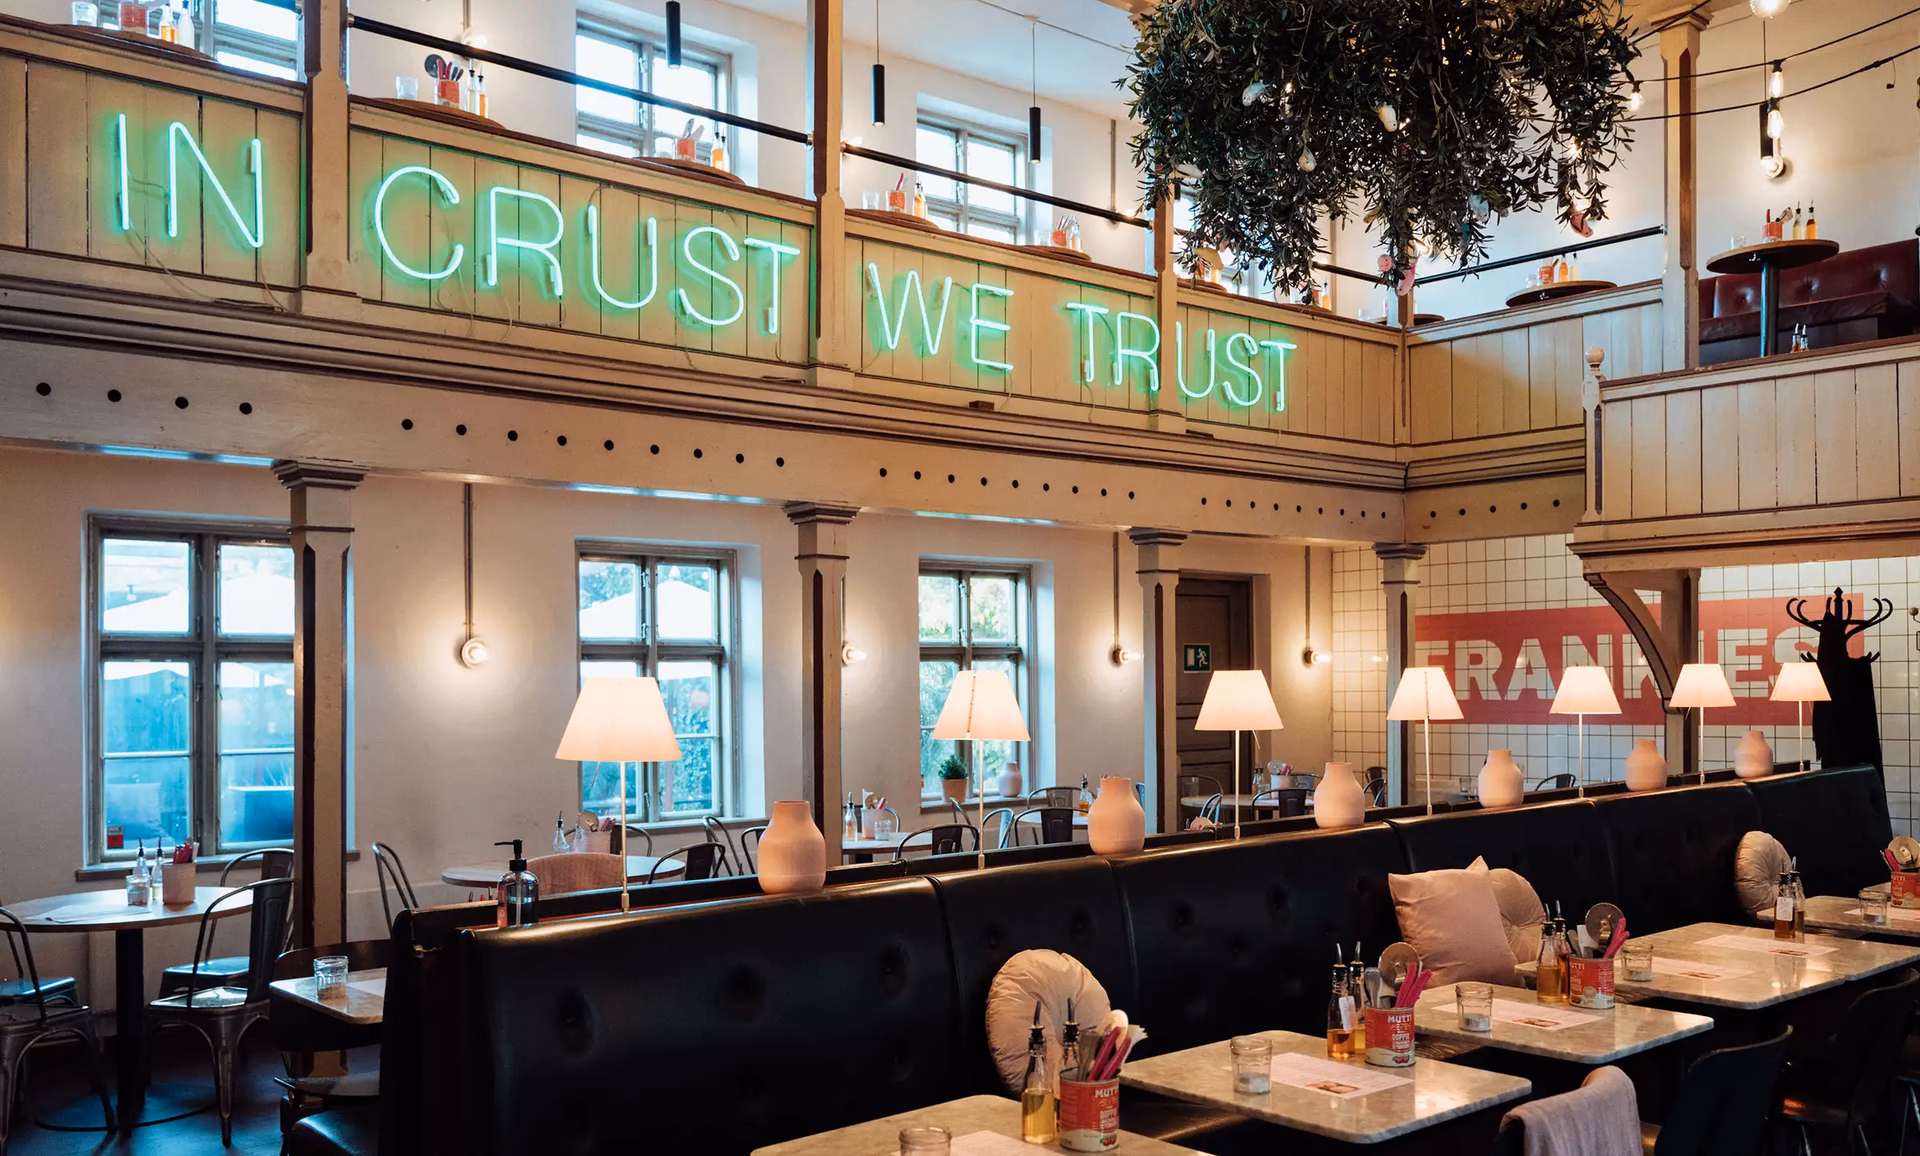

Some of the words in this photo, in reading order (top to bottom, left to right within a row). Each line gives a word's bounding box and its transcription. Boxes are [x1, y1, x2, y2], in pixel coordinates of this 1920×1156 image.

[117, 112, 265, 249] IN
[373, 165, 802, 336] CRUST
[867, 262, 1015, 372] WE
[1065, 302, 1299, 413] TRUST
